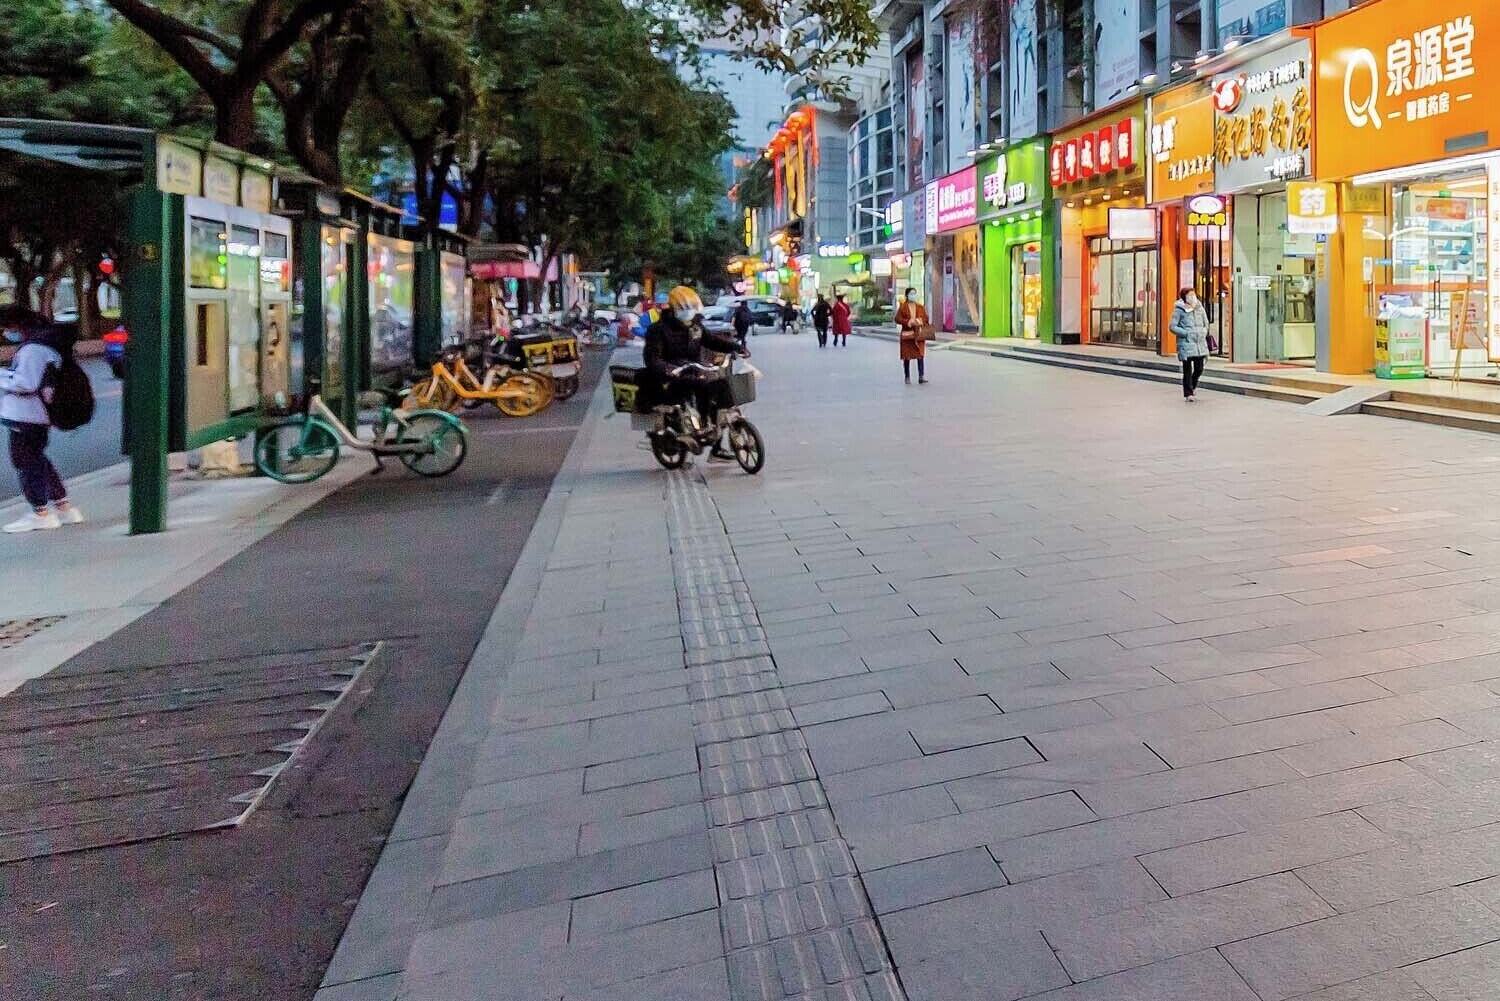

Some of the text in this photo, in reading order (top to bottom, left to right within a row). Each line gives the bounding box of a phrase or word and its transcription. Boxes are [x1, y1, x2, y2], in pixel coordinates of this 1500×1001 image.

[1386, 15, 1475, 97] 泉源堂
[1299, 186, 1326, 216] 药
